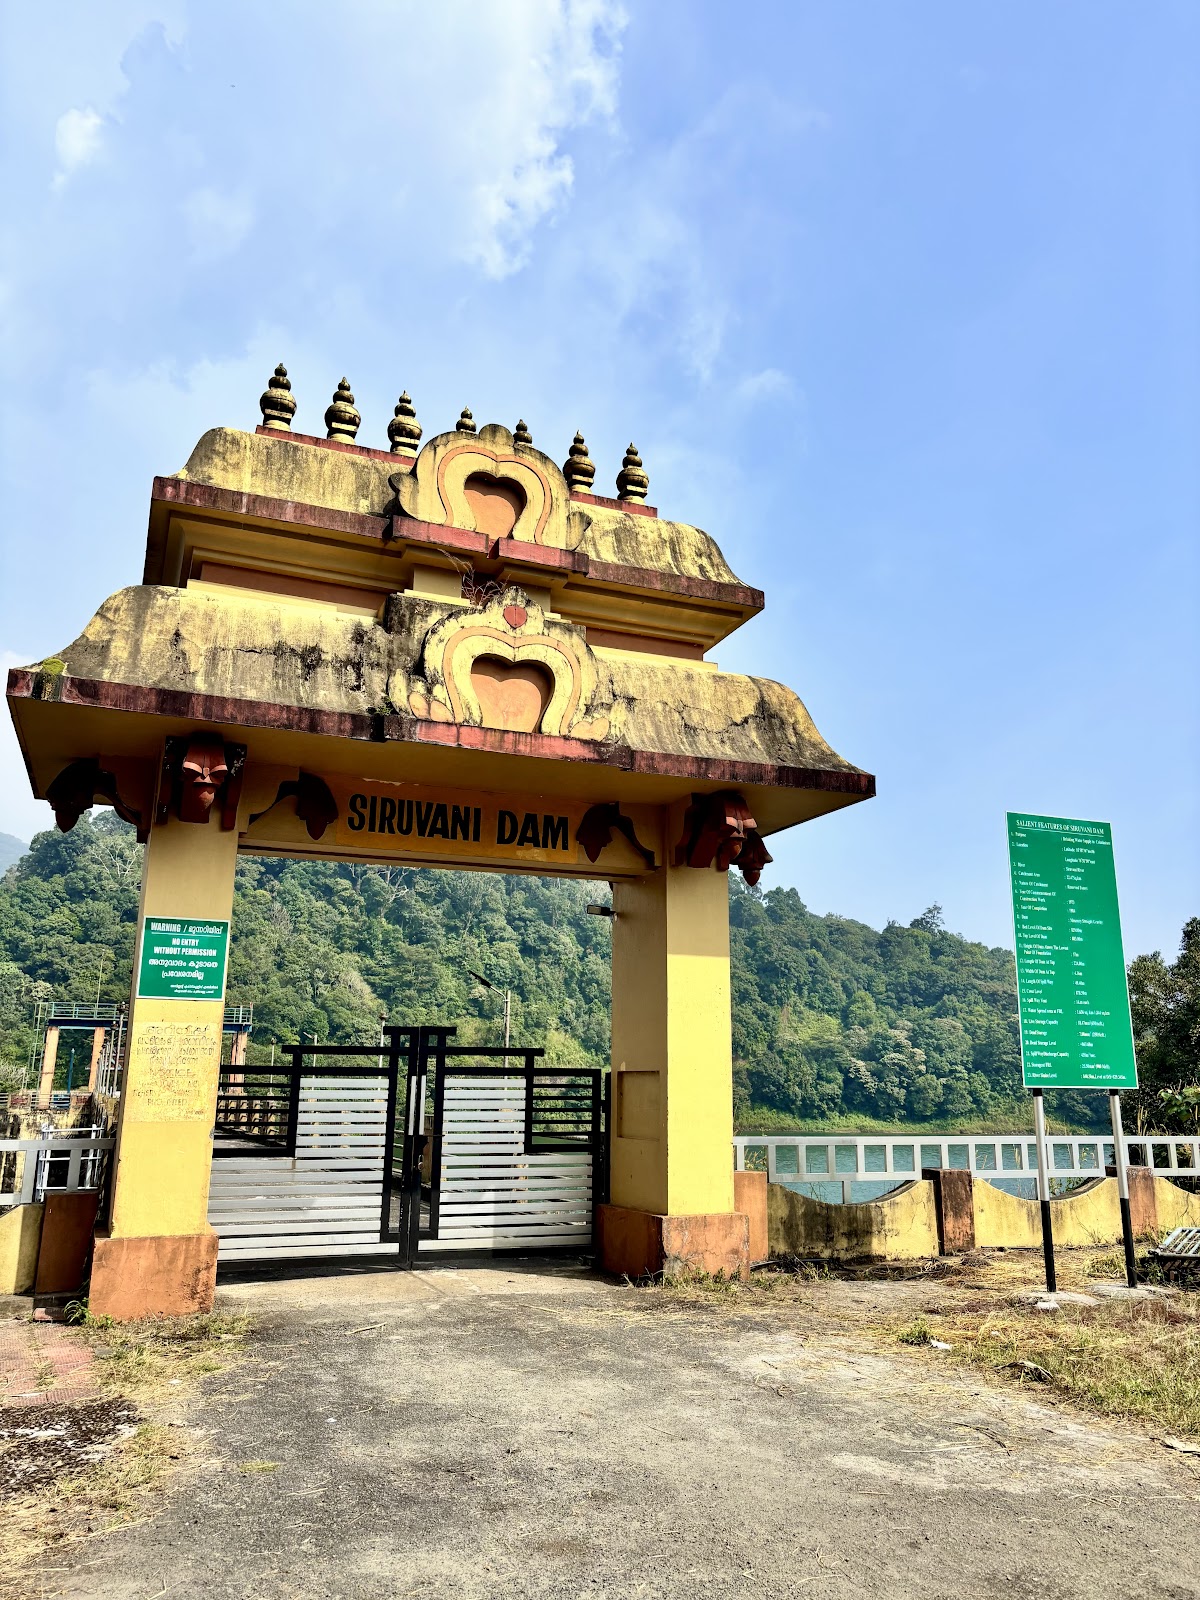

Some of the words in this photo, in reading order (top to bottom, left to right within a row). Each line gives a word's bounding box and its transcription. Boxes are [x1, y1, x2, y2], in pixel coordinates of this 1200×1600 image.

[347, 793, 482, 842] SIRUVANI
[496, 809, 569, 851] DAM
[1016, 820, 1037, 828] SALIENT
[1038, 822, 1062, 830] FEATURES
[1070, 825, 1092, 833] SIRUVANI
[151, 922, 181, 933] WARNING
[183, 925, 188, 933] /
[172, 938, 180, 946] NO
[181, 938, 199, 947] ENTRY
[154, 946, 181, 955] WITHOUT
[182, 948, 217, 957] PERMISSION
